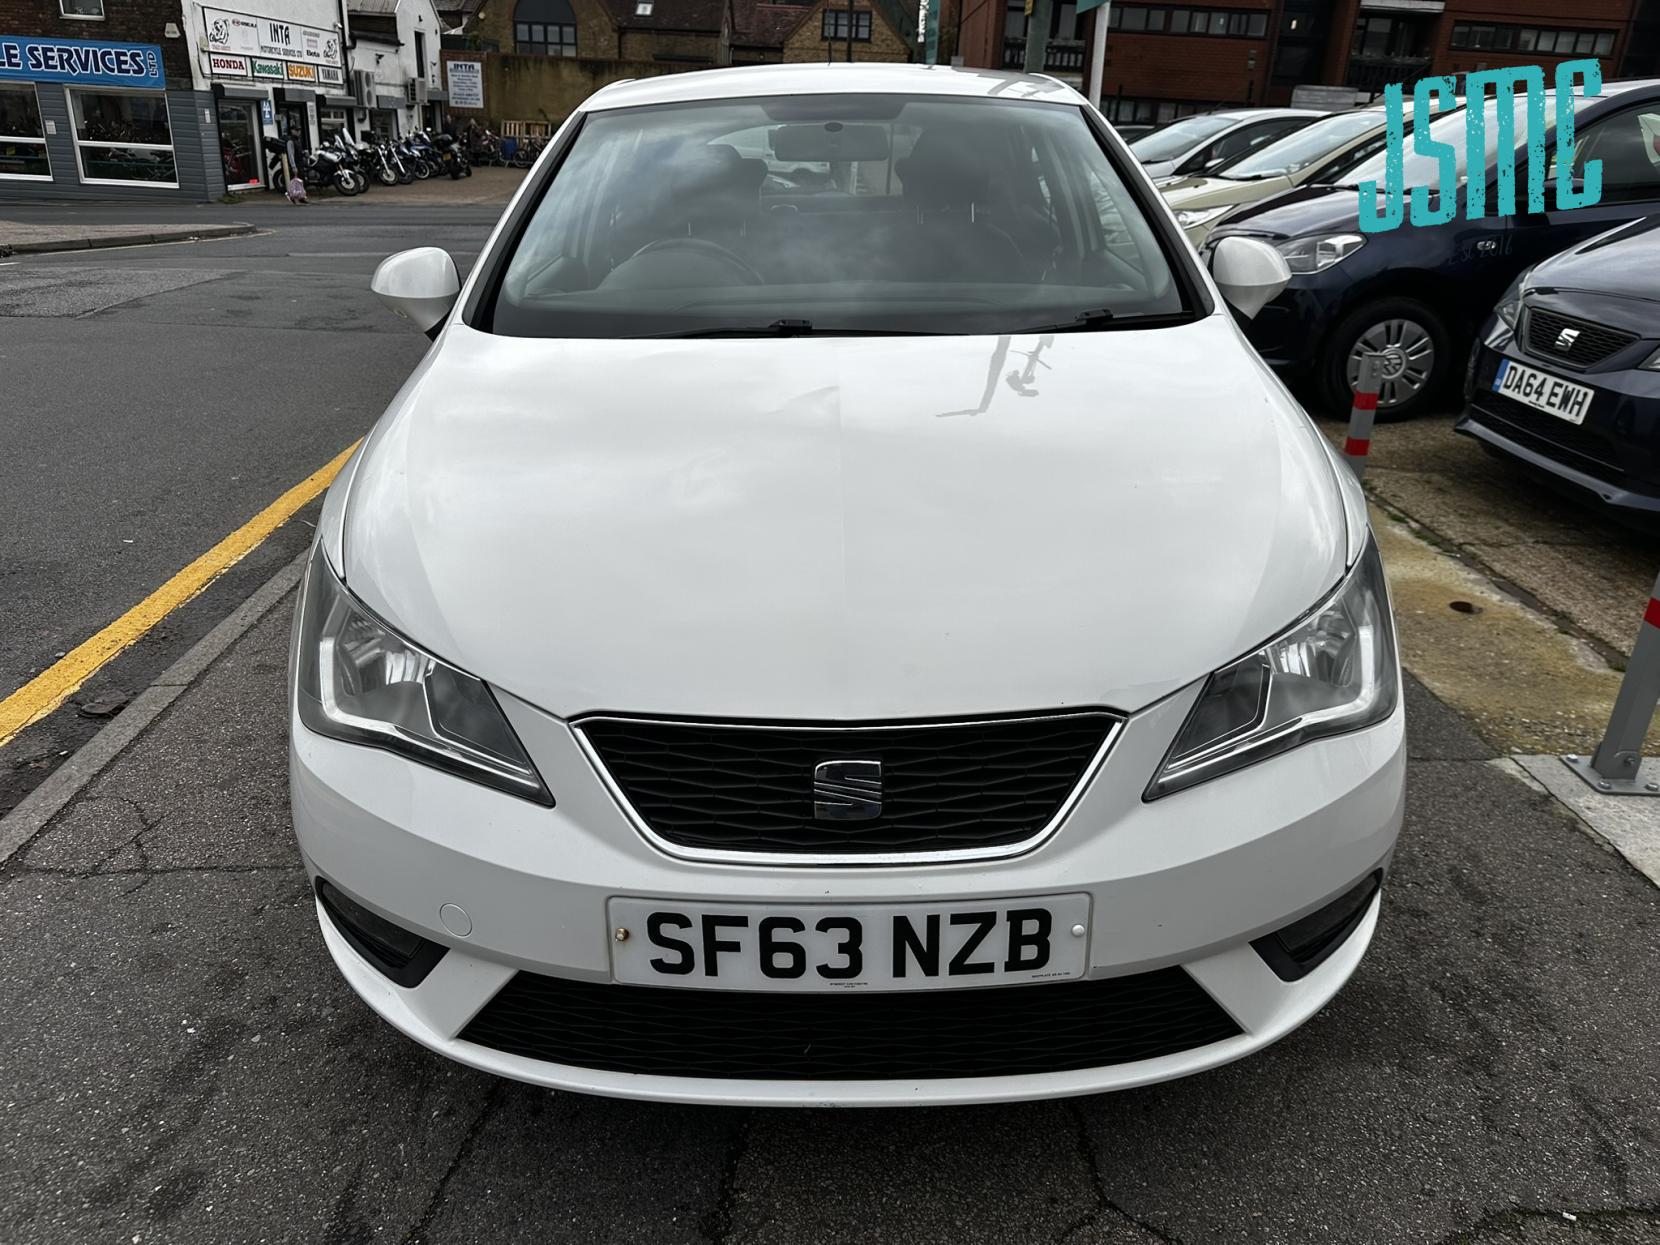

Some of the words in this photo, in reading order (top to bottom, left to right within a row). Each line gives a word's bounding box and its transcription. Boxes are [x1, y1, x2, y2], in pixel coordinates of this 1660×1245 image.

[269, 22, 290, 46] INTA
[26, 44, 146, 77] SERVICES
[146, 50, 159, 78] LTD
[212, 58, 245, 70] HONDA
[251, 59, 284, 76] Kawasaki
[288, 64, 315, 79] SUZUKI
[321, 68, 339, 81] YAMAHA
[1502, 365, 1548, 402] DA64
[1545, 380, 1589, 417] EWH
[645, 910, 863, 979] SF63
[891, 908, 1053, 979] NZB
